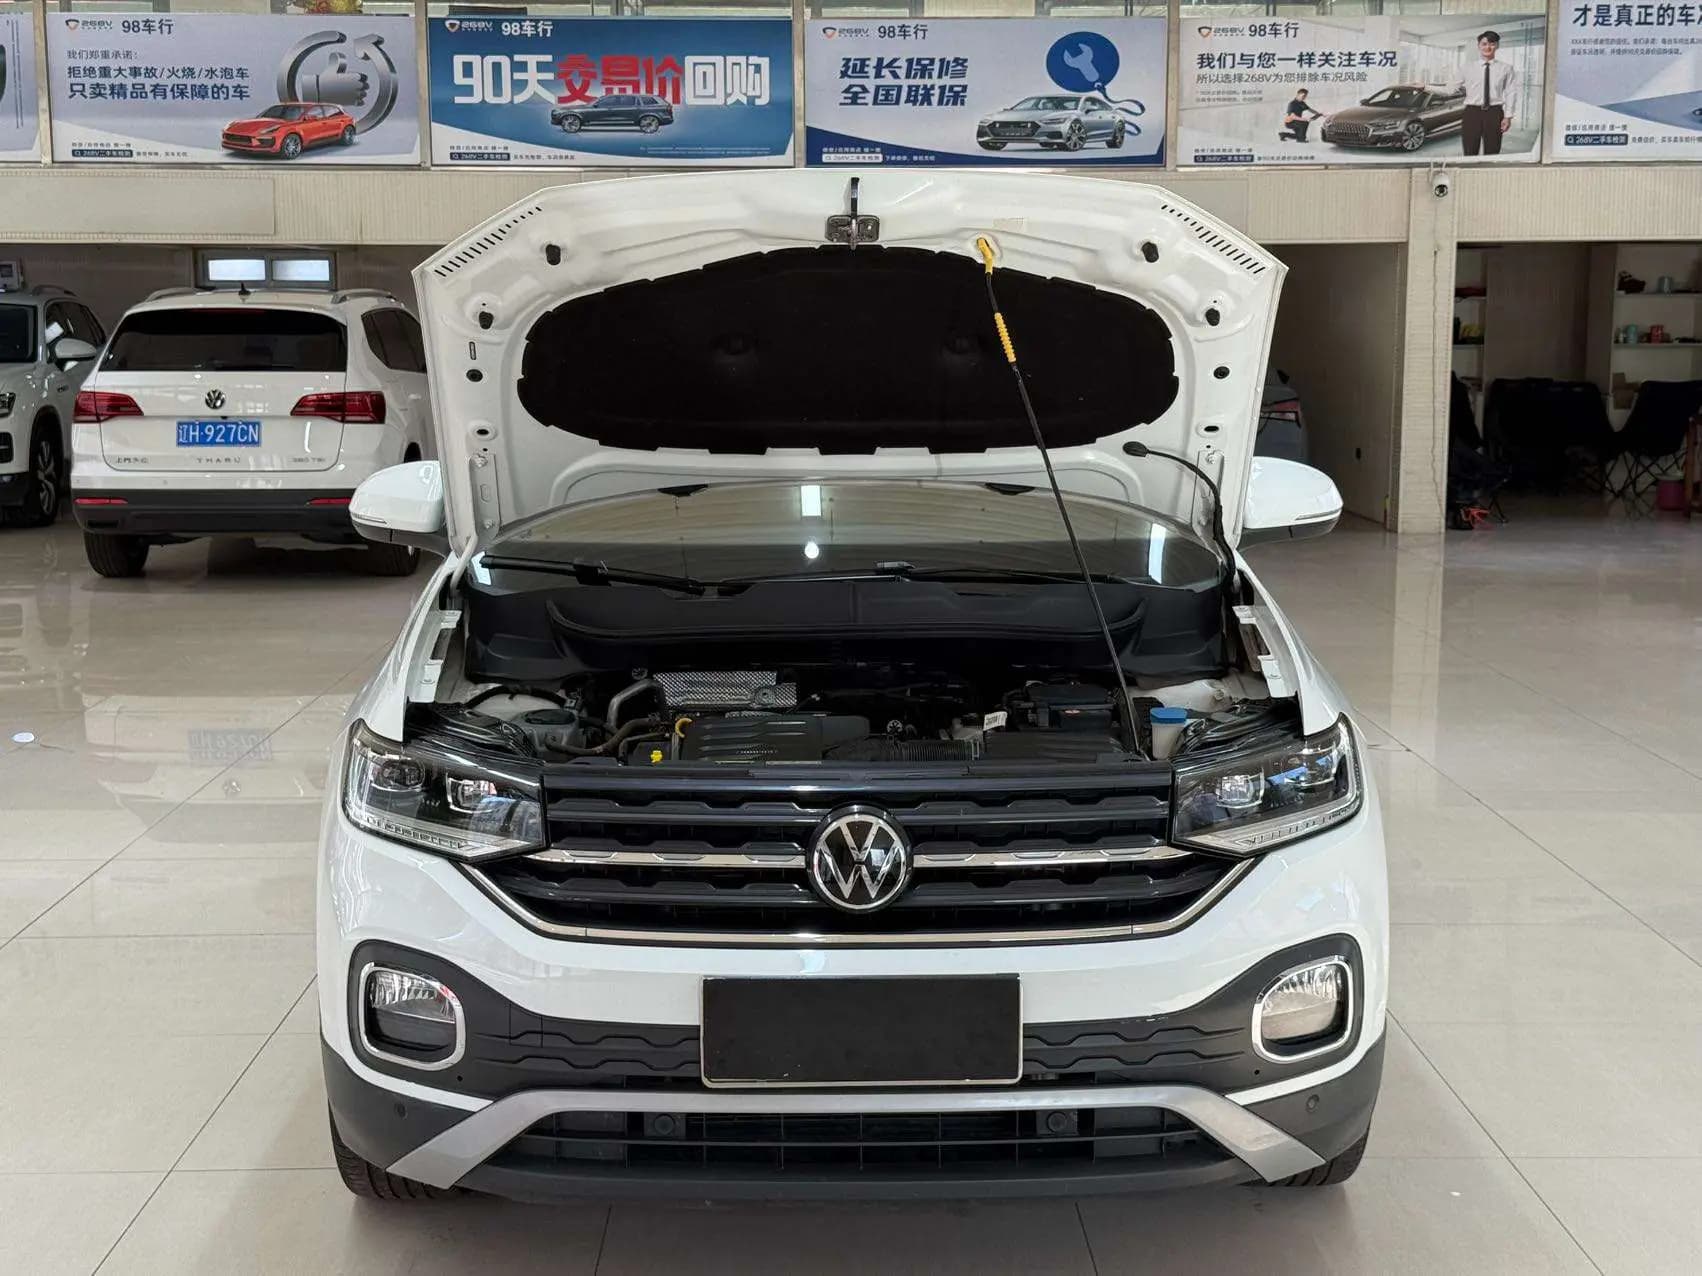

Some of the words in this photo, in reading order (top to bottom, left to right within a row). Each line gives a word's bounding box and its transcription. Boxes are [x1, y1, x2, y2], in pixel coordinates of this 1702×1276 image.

[1572, 3, 1702, 27] 才是真正的车
[121, 18, 174, 34] 98车行
[501, 20, 554, 37] 98车行
[877, 23, 929, 40] 98车行
[1248, 22, 1300, 38] 98车行
[838, 56, 969, 80] 延长保修
[1196, 51, 1398, 69] 我们与您一样关注车况
[67, 66, 250, 80] 拒绝重大事故/火烧/水泡车
[1195, 71, 1369, 84] 所以选择268V为您排除车况风险
[68, 83, 251, 101] 只卖精品有保障的车
[838, 83, 968, 107] 全国联保
